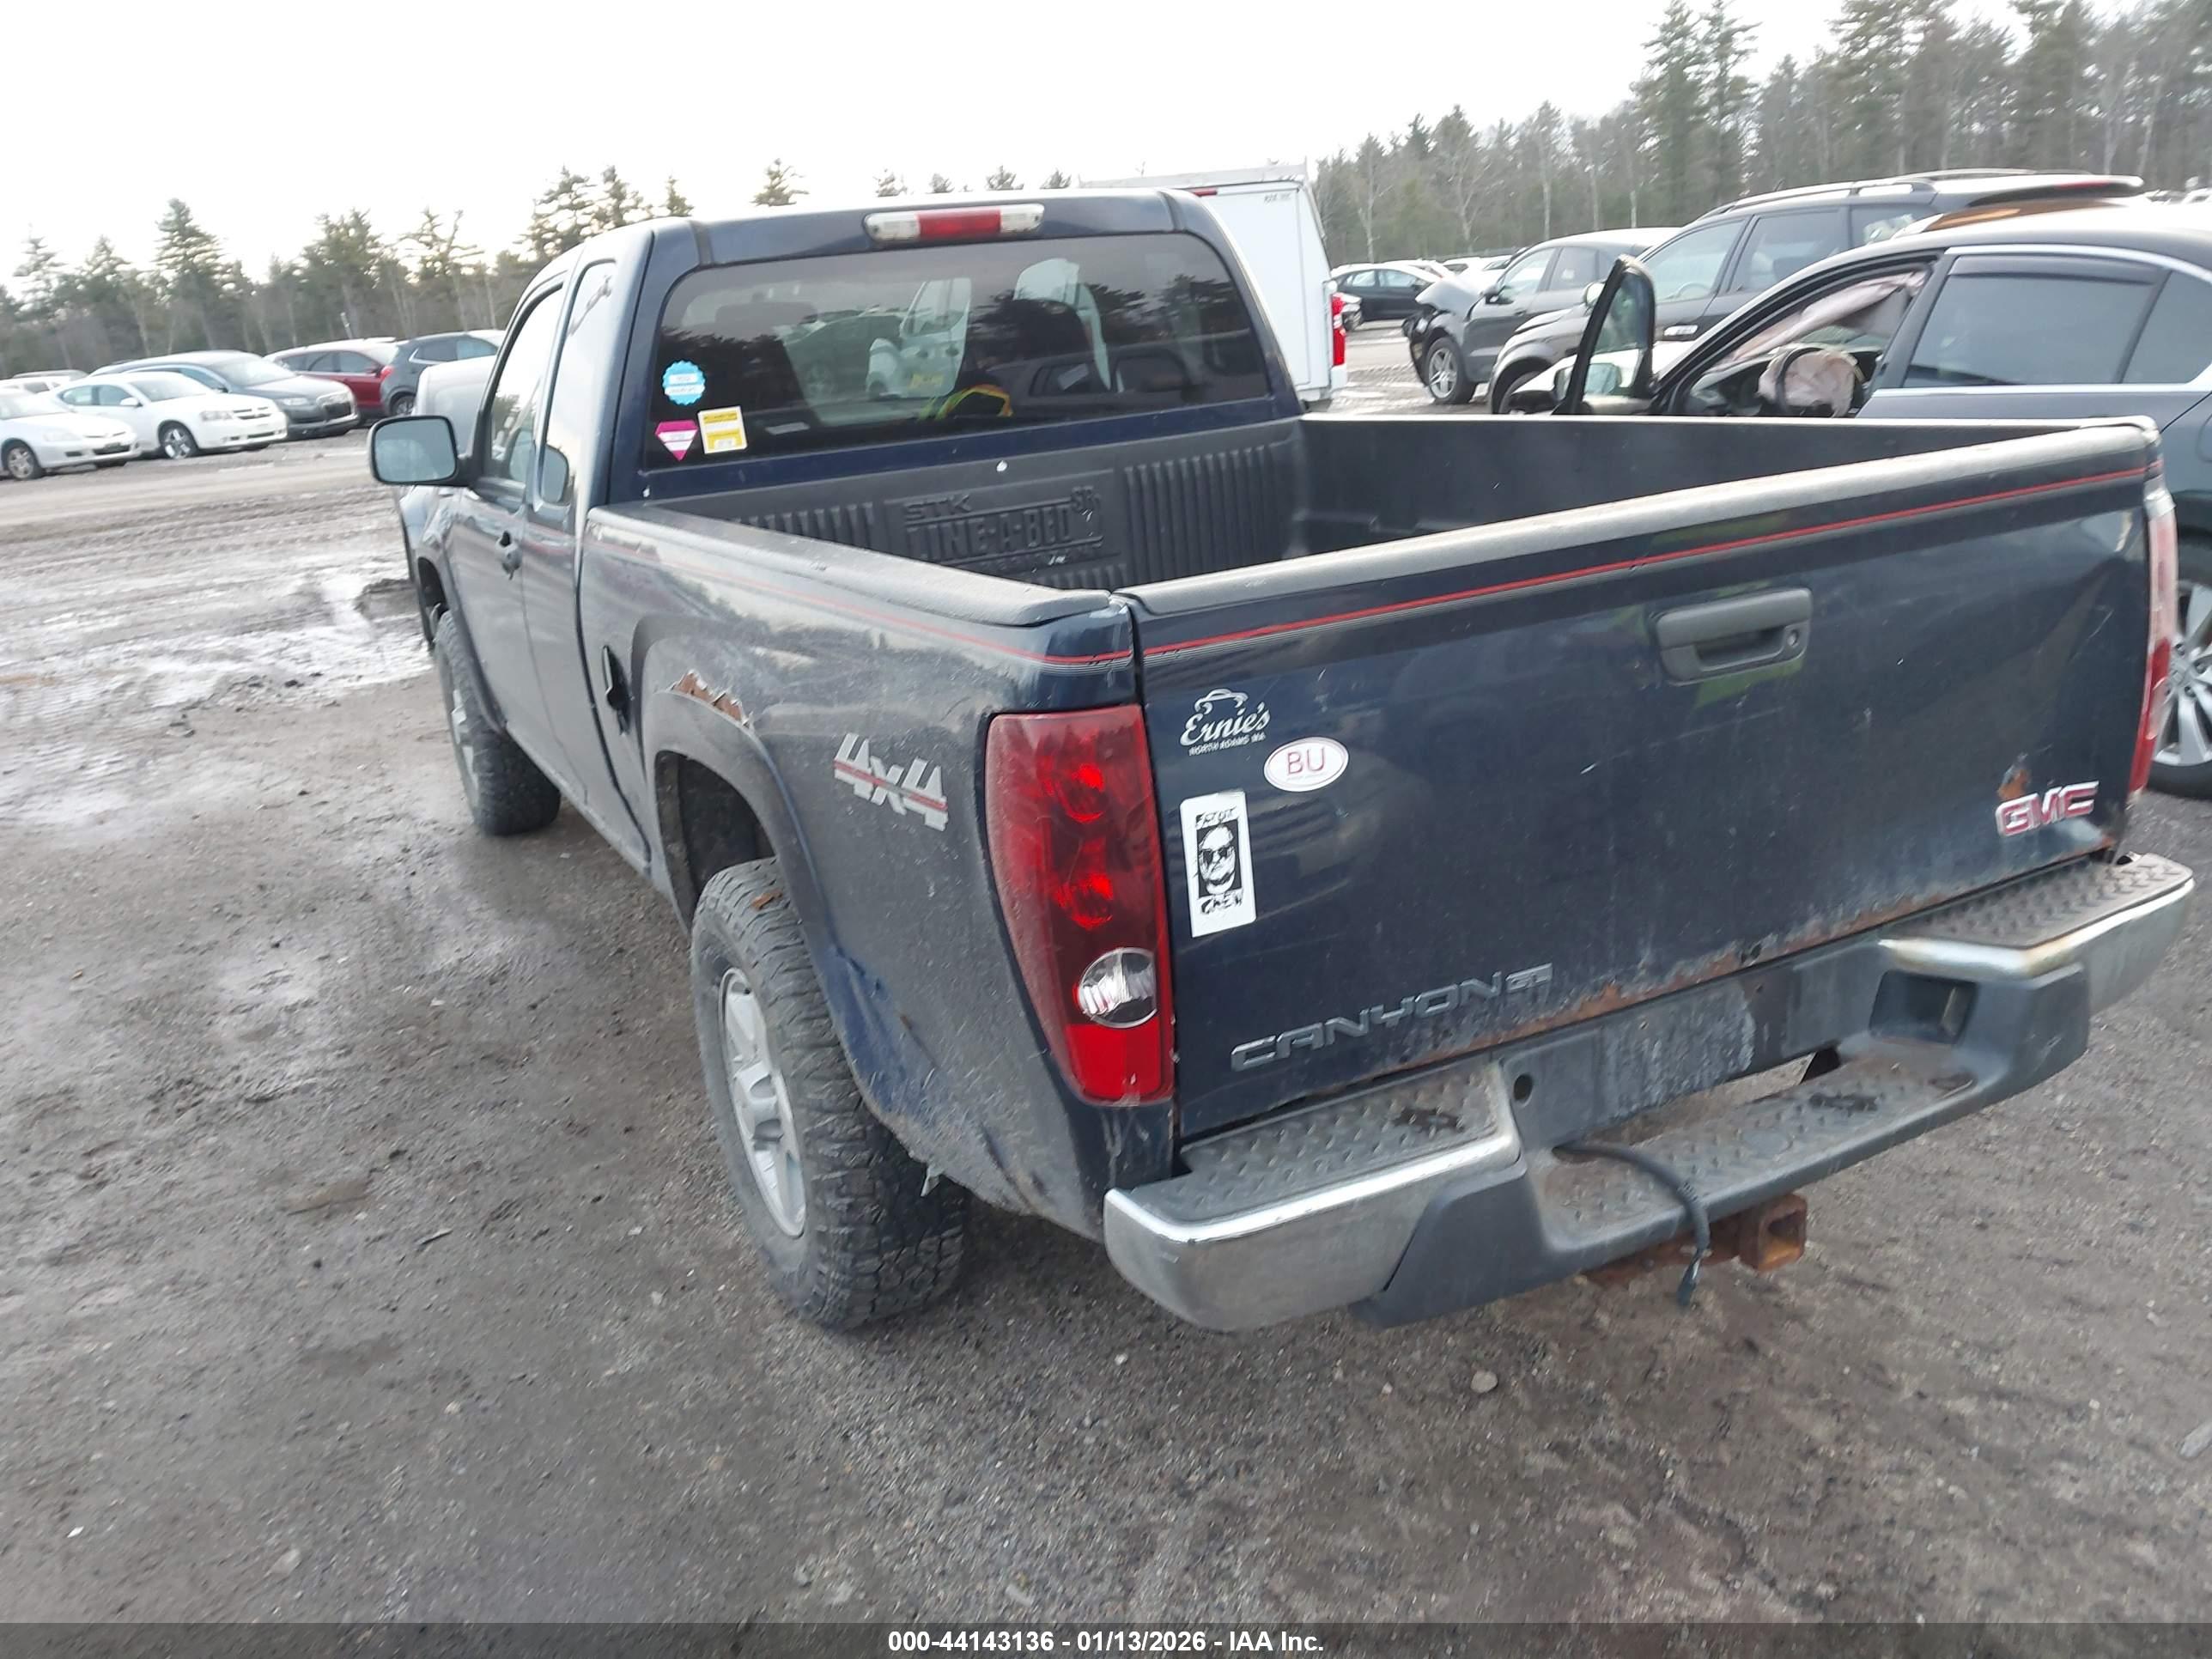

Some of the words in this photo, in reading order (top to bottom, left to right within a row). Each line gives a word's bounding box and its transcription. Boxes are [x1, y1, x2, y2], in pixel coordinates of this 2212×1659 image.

[1180, 701, 1271, 746] Ernie's
[1287, 746, 1326, 775] BU
[1995, 780, 2100, 837] GMC
[1230, 970, 1502, 1073] CANYON
